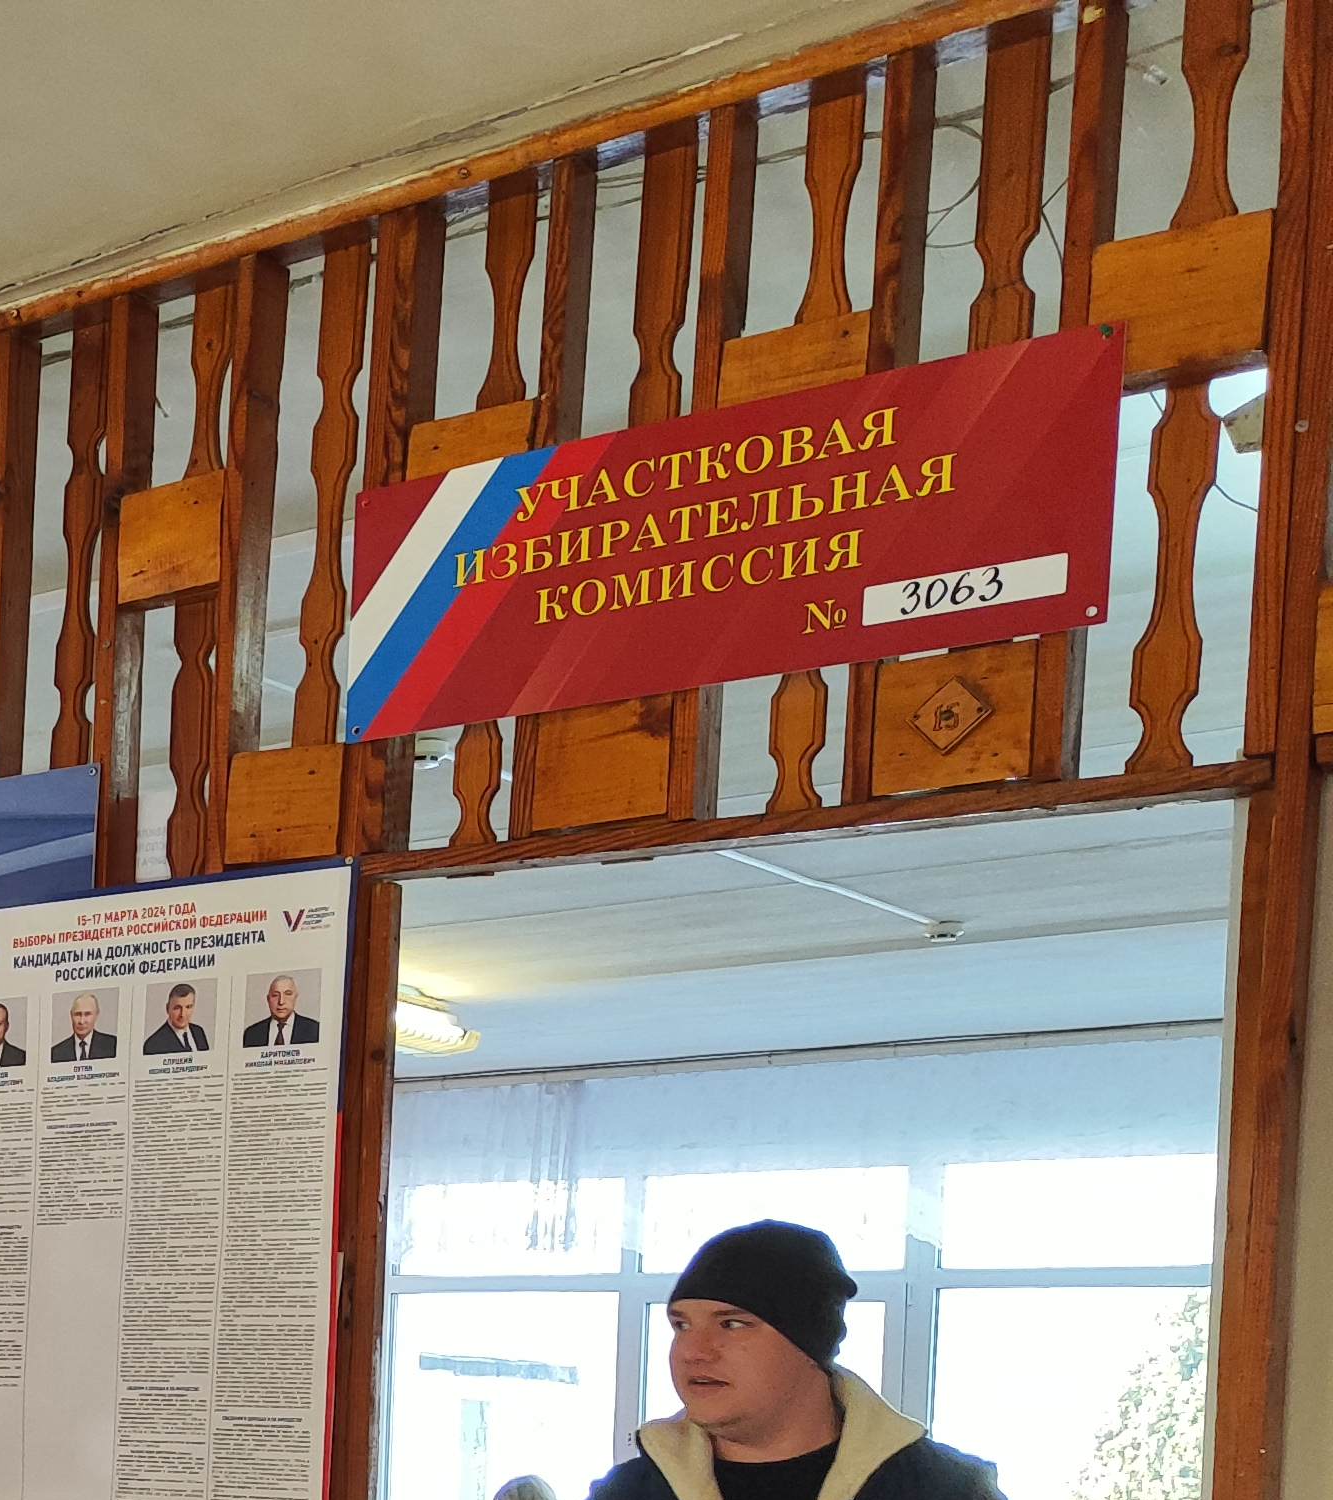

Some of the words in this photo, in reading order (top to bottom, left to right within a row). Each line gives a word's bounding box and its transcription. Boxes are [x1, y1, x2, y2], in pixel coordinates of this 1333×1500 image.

[515, 407, 900, 522] УЧАСТКОВАЯ
[453, 453, 957, 589] ИЗБИРАТЕЛЬНАЯ
[533, 529, 863, 626] КОМИССИЯ
[803, 598, 847, 636] №
[898, 566, 1005, 616] 3063
[13, 935, 56, 949] ВЫБОРЫ
[58, 927, 124, 944] ПРЕЗИДЕНТА
[126, 916, 197, 936] РОССИЙСКОЙ
[199, 910, 268, 929] ФЕДЕРАЦИИ
[77, 914, 102, 926] 15-17
[104, 909, 139, 924] МАРТА
[141, 906, 166, 919] 2024
[168, 902, 197, 917] ГОДА
[13, 950, 84, 969] КАНДИДАТЫ
[87, 946, 103, 961] НА
[105, 939, 181, 962] ДОЛЖНОСТЬ
[184, 930, 266, 951] ПРЕЗИДЕНТА
[54, 960, 135, 983] РОССИЙСКОЙ
[139, 954, 215, 975] ФЕДЕРАЦИИ
